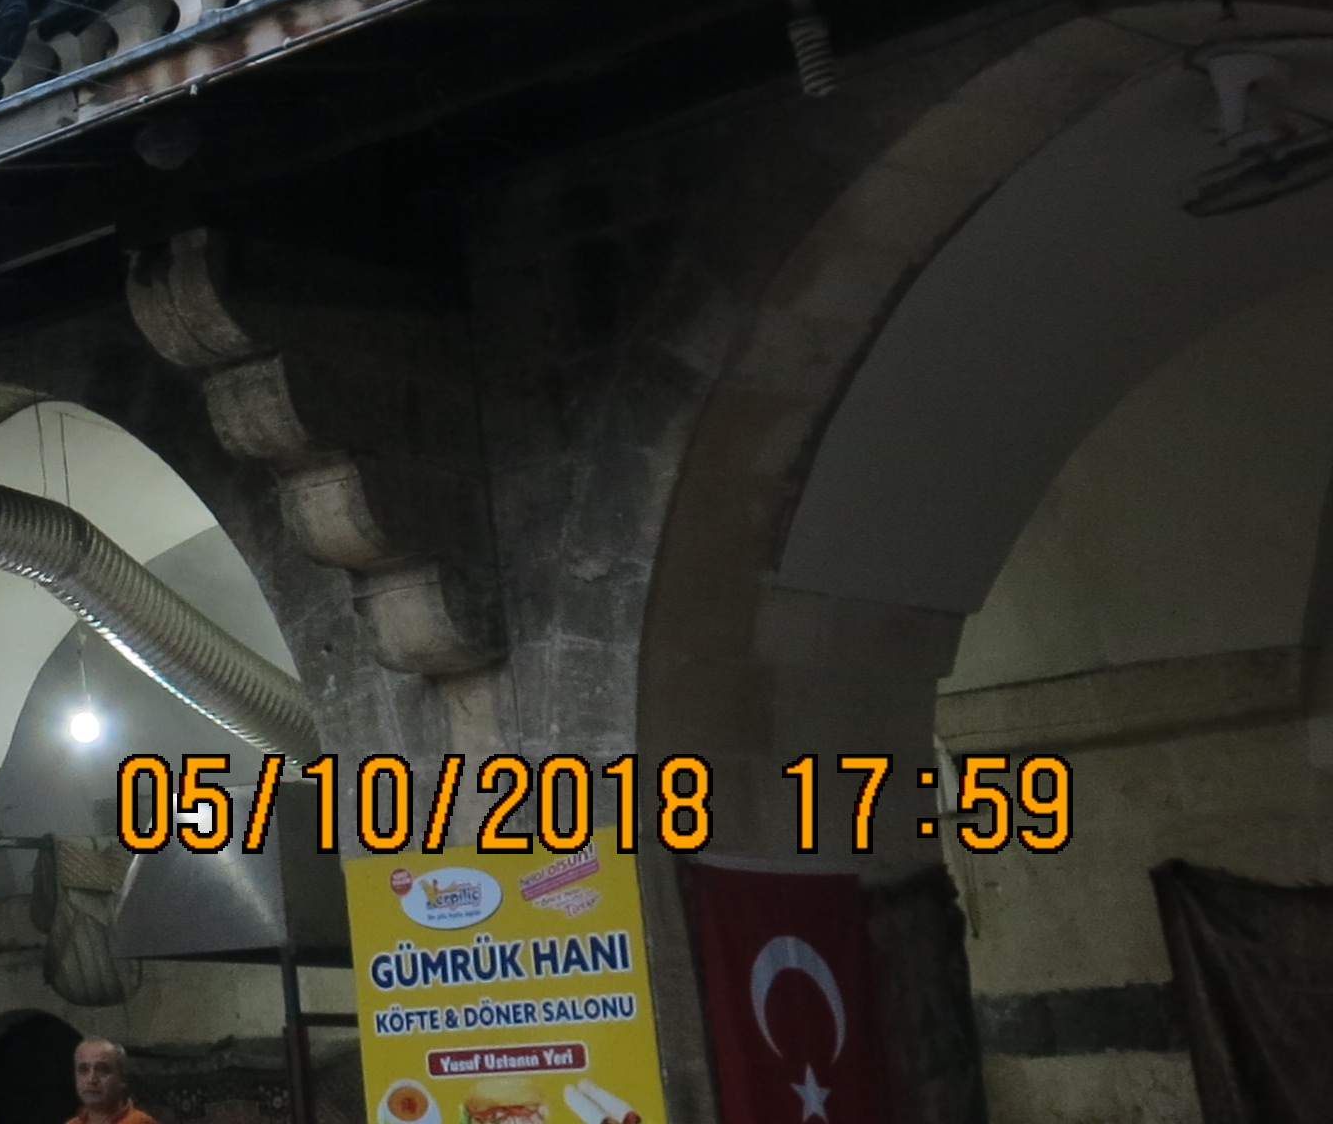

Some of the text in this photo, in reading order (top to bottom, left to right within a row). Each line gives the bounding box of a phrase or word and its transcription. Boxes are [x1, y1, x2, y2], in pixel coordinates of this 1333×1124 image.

[371, 933, 631, 989] GÜMRÜK HANI
[375, 996, 634, 1034] KÖFTE & DÖNER SALONU
[440, 1054, 482, 1074] Yusuf
[542, 1049, 574, 1067] Yeri
